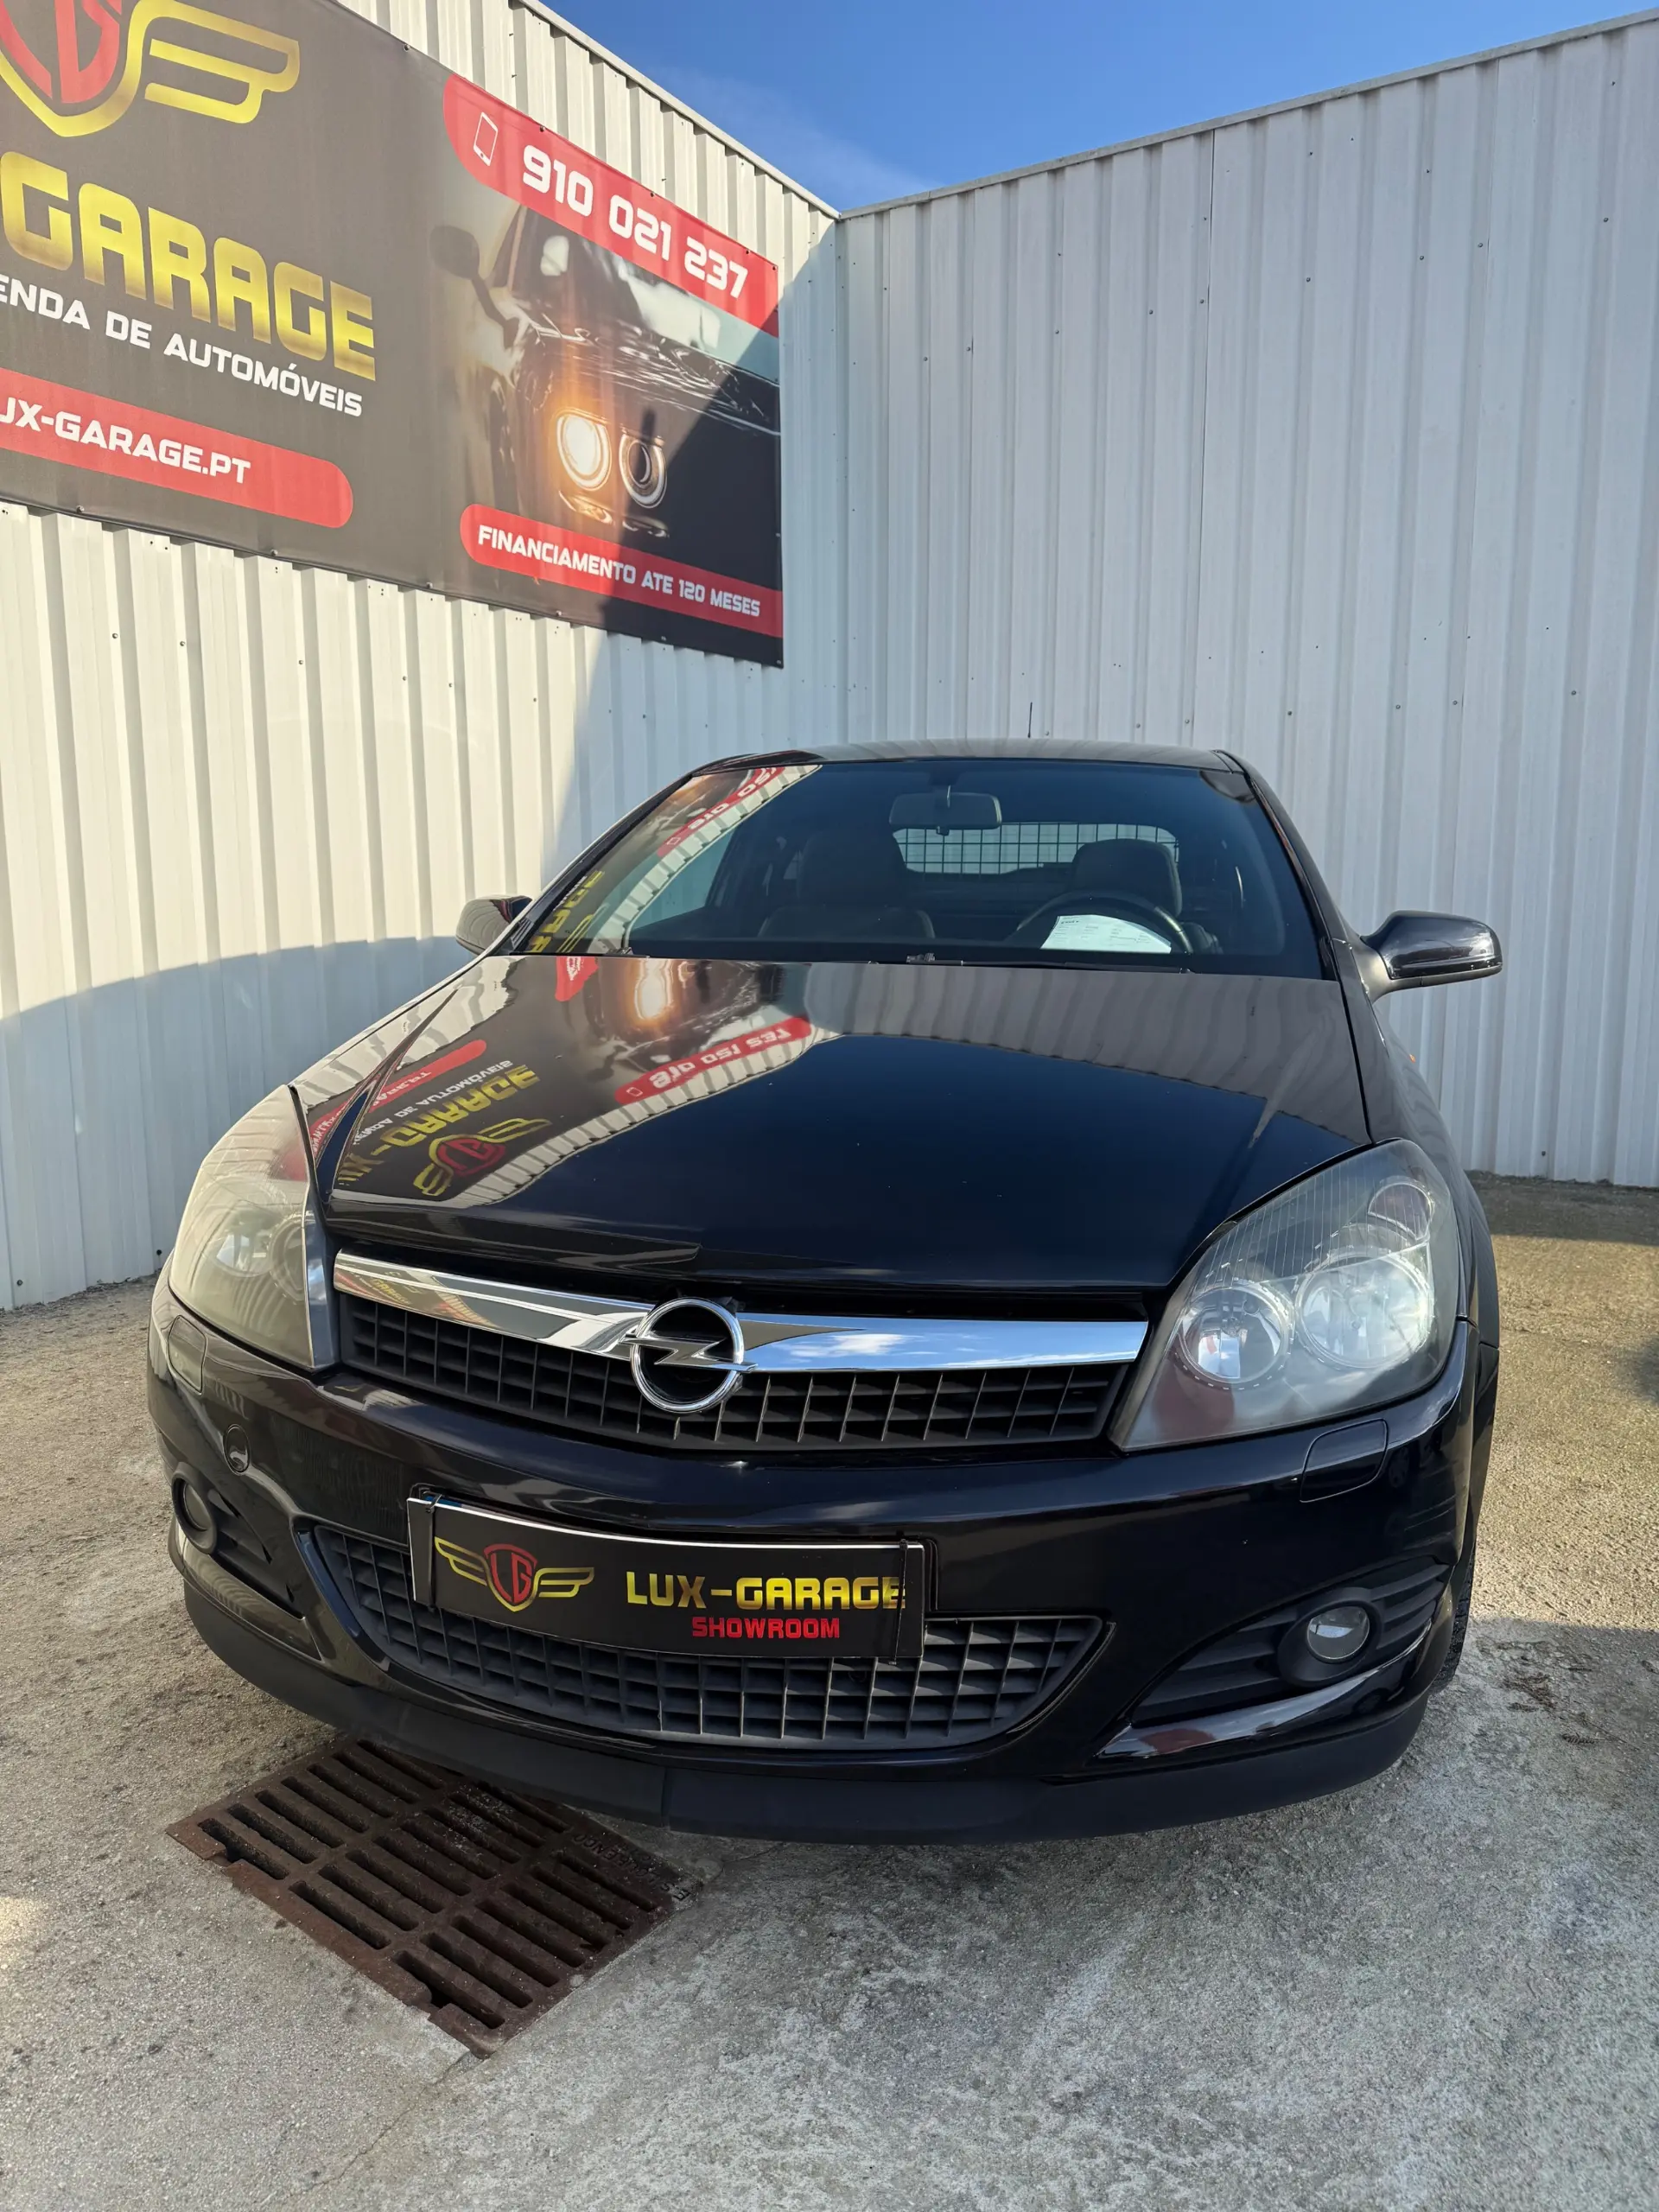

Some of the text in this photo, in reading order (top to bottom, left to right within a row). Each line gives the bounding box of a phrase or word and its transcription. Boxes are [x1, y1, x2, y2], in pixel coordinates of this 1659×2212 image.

[0, 150, 377, 381] GARAGE
[523, 144, 748, 299] 910 021 237
[106, 310, 153, 350] DE
[163, 333, 363, 417] AUTOMÓVEIS
[478, 524, 761, 617] FINANCIAMENTO ATE 120 MESES
[626, 1571, 906, 1610] LUX-GARAGE
[692, 1617, 840, 1639] SHOWROOM
